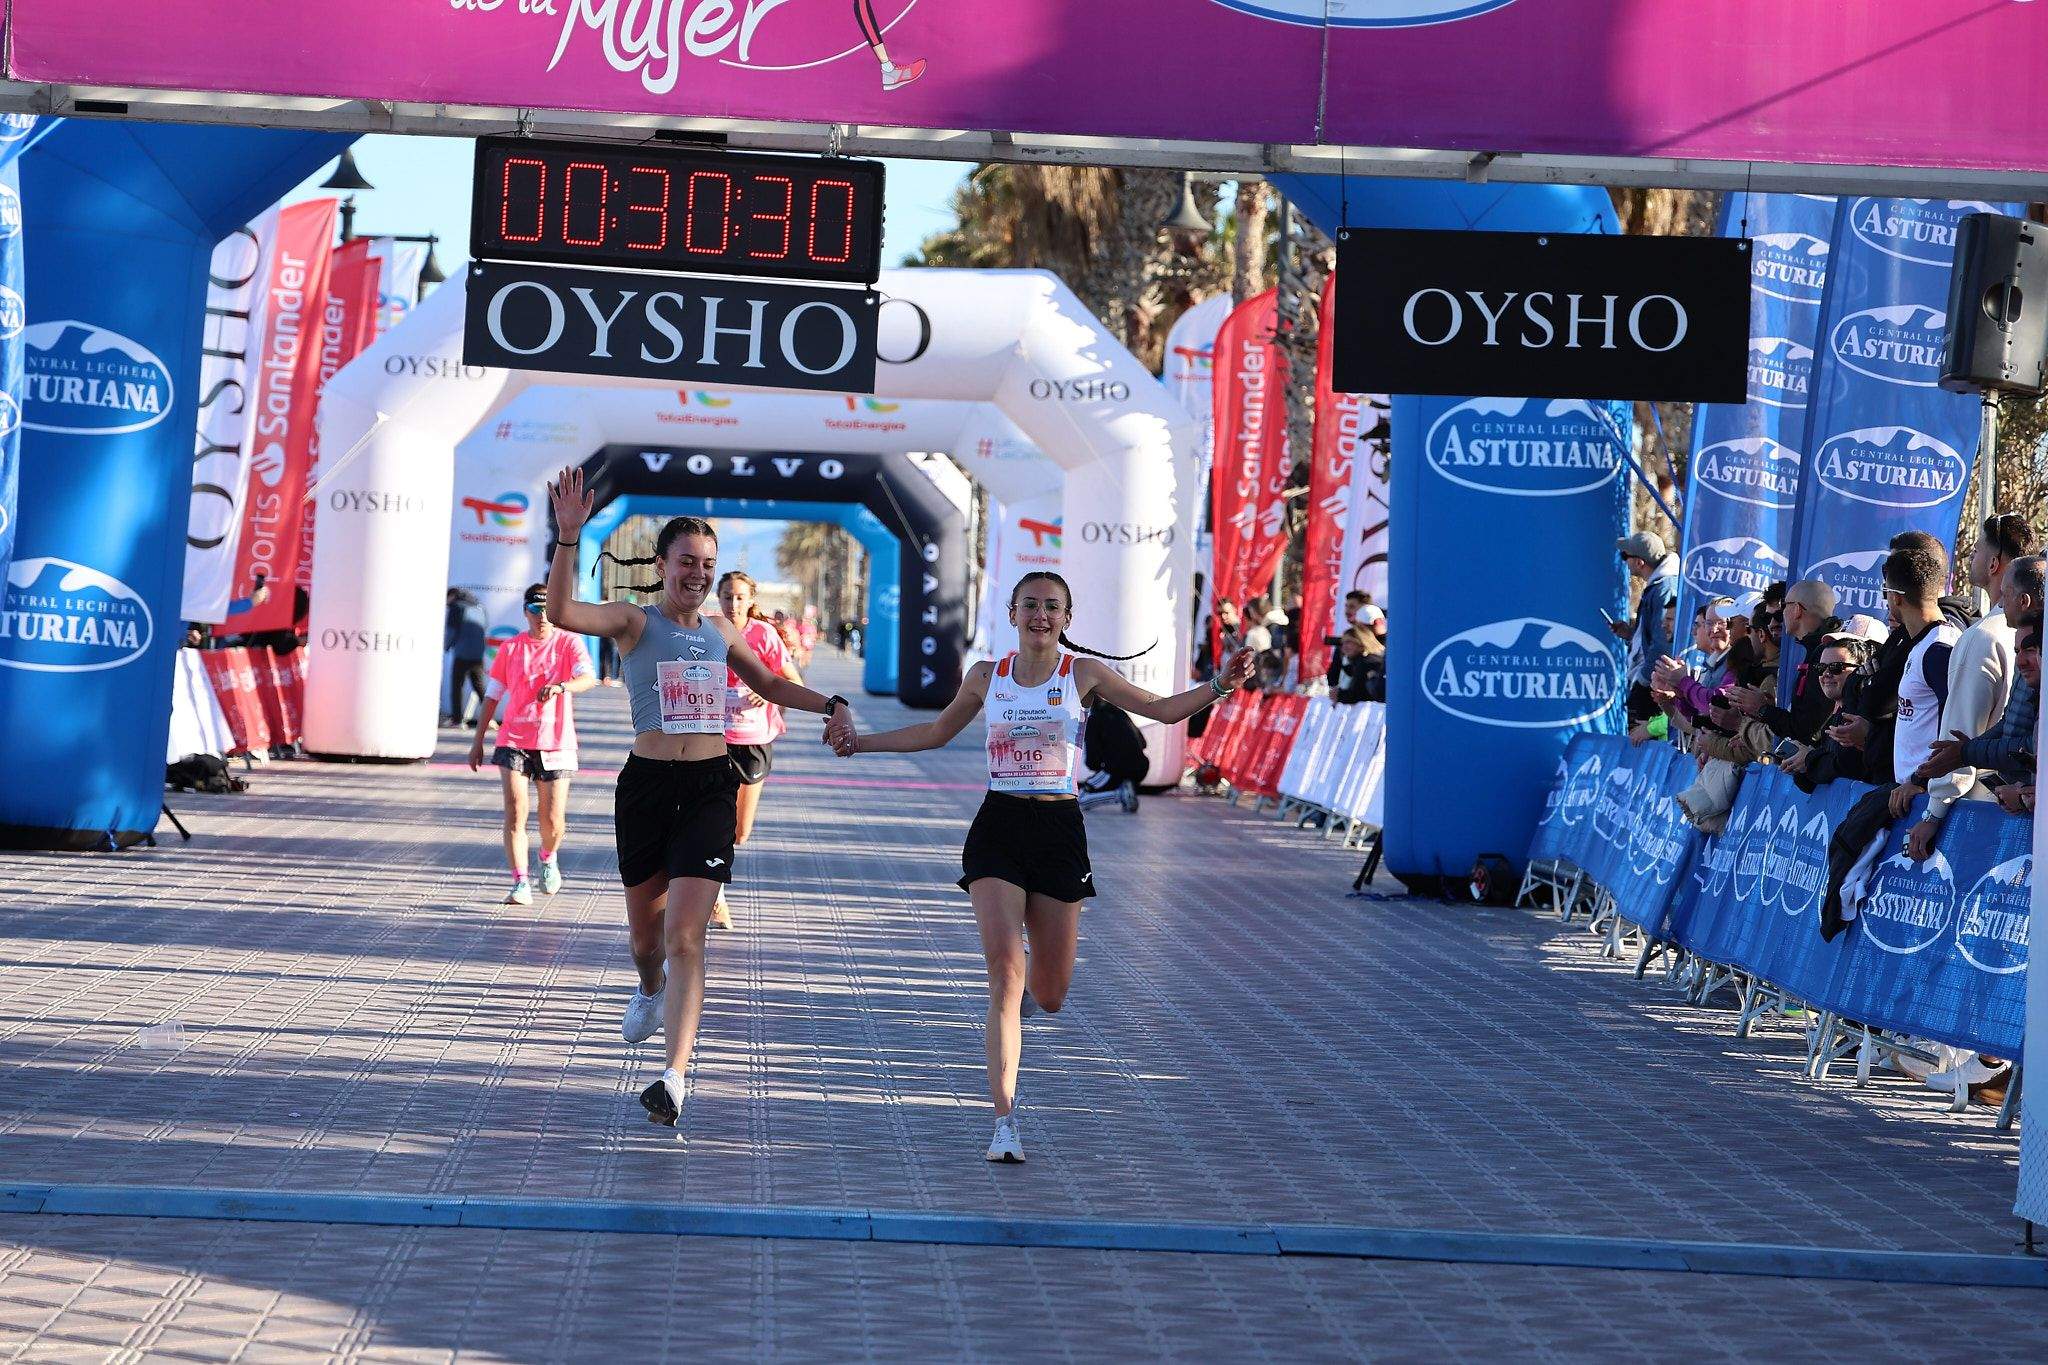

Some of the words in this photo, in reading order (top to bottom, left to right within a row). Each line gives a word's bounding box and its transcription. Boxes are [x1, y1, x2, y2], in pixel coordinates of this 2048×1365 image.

[546, 0, 790, 94] Mujer
[501, 158, 854, 262] 00:30:30
[1859, 203, 1957, 247] ASTURI
[1890, 204, 1944, 221] CENTRAL
[1751, 259, 1826, 290] STURIA
[1760, 249, 1806, 266] CENTRAL
[486, 281, 858, 376] OYSHO
[1403, 288, 1688, 352] OYSHO
[1869, 326, 1922, 341] CENTRAL
[257, 252, 306, 437] Santander
[28, 356, 79, 372] NTRAL
[86, 359, 158, 380] LECHERA
[1748, 365, 1808, 394] TURIA
[24, 374, 162, 414] TURIANA
[1029, 378, 1130, 401] OYSHO
[1237, 340, 1266, 498] Santander
[1472, 423, 1545, 435] CENTRAL
[1552, 424, 1605, 437] LECHER
[1439, 424, 1614, 469] ASTURIANA
[1725, 455, 1770, 470] CENTRAL
[1851, 448, 1904, 462] CENTRAL
[1909, 456, 1955, 469] LECHERA
[640, 451, 845, 480] VOLVO
[1702, 454, 1799, 495] ASTURIAN
[1822, 447, 1955, 492] ASTURIANA
[239, 492, 282, 600] ports
[1710, 556, 1752, 569] CENTRAL
[1834, 573, 1882, 587] CENTRA
[8, 594, 58, 609] NTRAL
[66, 598, 137, 615] LECHERA
[921, 542, 940, 689] VOLVO
[0, 610, 140, 649] TURIANA
[1434, 655, 1610, 700] ASTURIANA
[1467, 653, 1540, 666] CENTRAL
[1547, 655, 1606, 668] LECHERA
[687, 693, 714, 705] 016
[1013, 750, 1043, 762] 016
[1864, 875, 1944, 930] ASTURIANA
[1961, 893, 2030, 946] ASTURIA
